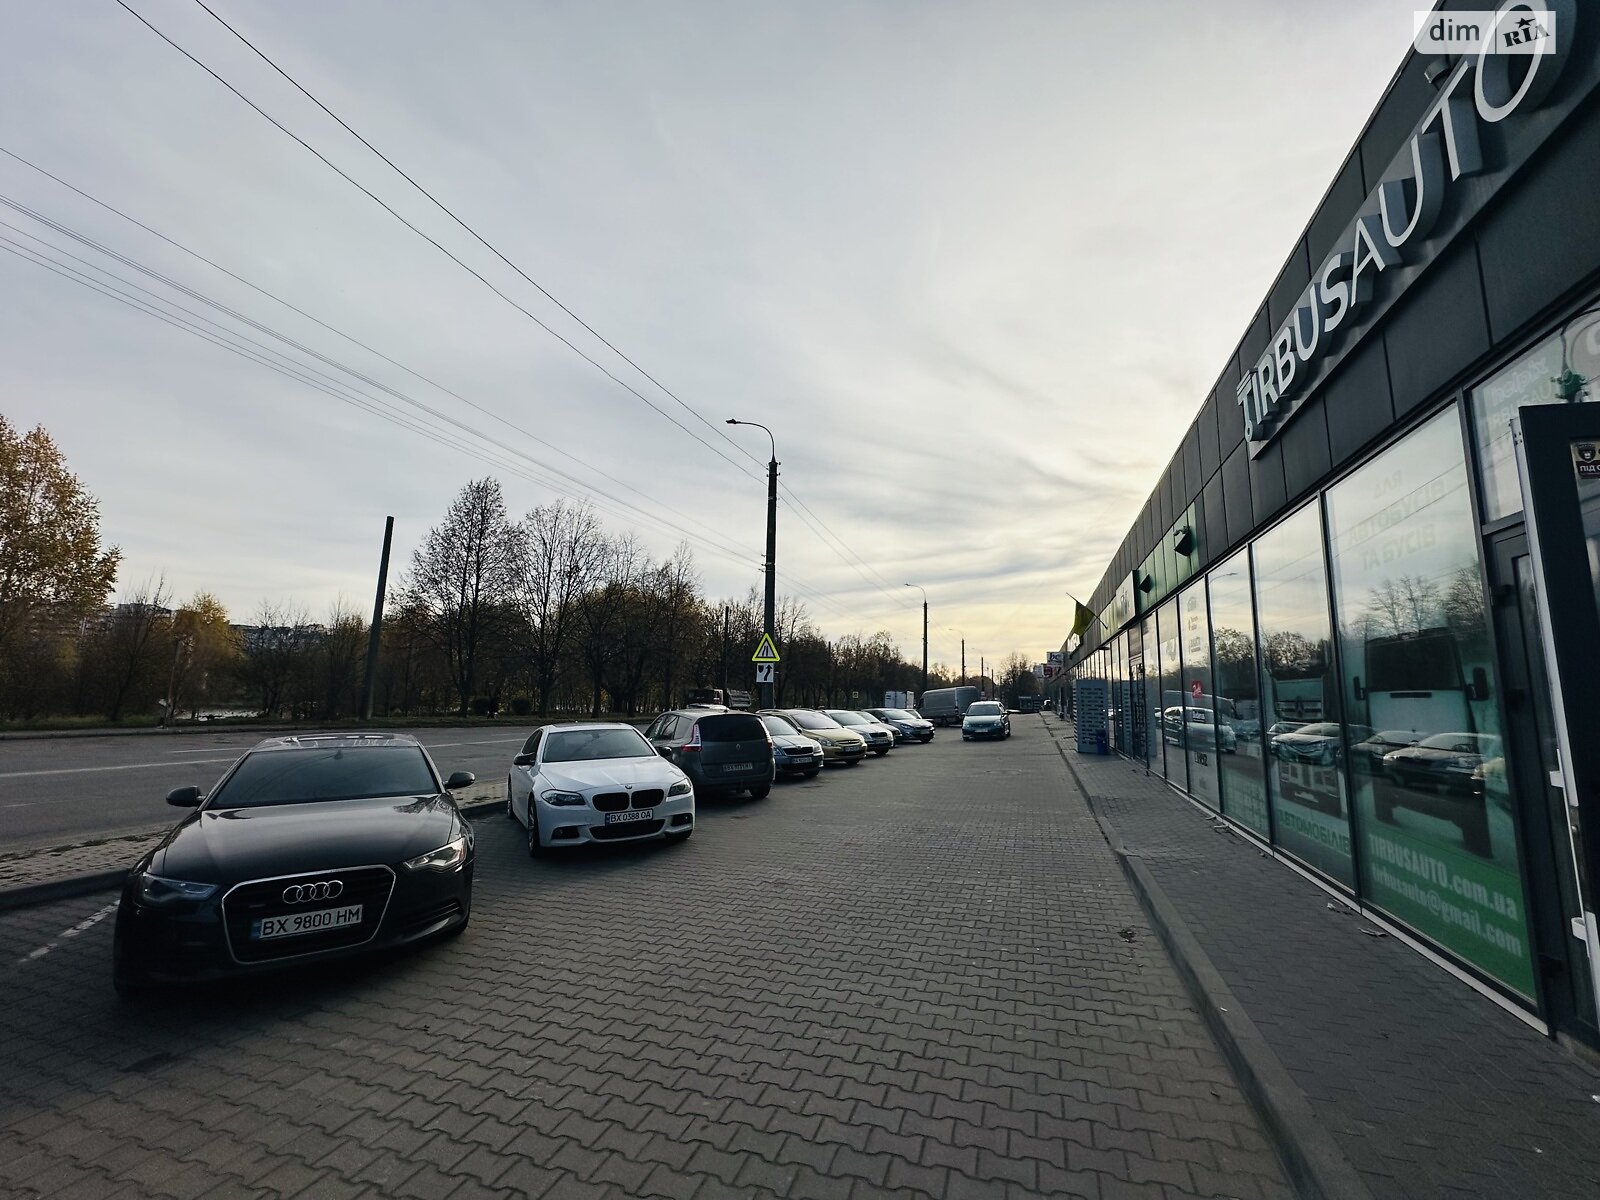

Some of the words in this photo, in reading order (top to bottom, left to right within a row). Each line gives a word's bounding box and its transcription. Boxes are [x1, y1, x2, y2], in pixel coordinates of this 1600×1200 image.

[1237, 0, 1549, 443] TIRBUSAUTO
[610, 814, 621, 822] BX
[640, 811, 651, 819] OA
[1368, 833, 1518, 921] TIRBUSAUTO.com.ua
[262, 918, 289, 936] BX
[293, 912, 332, 931] 9800
[336, 907, 361, 924] HM
